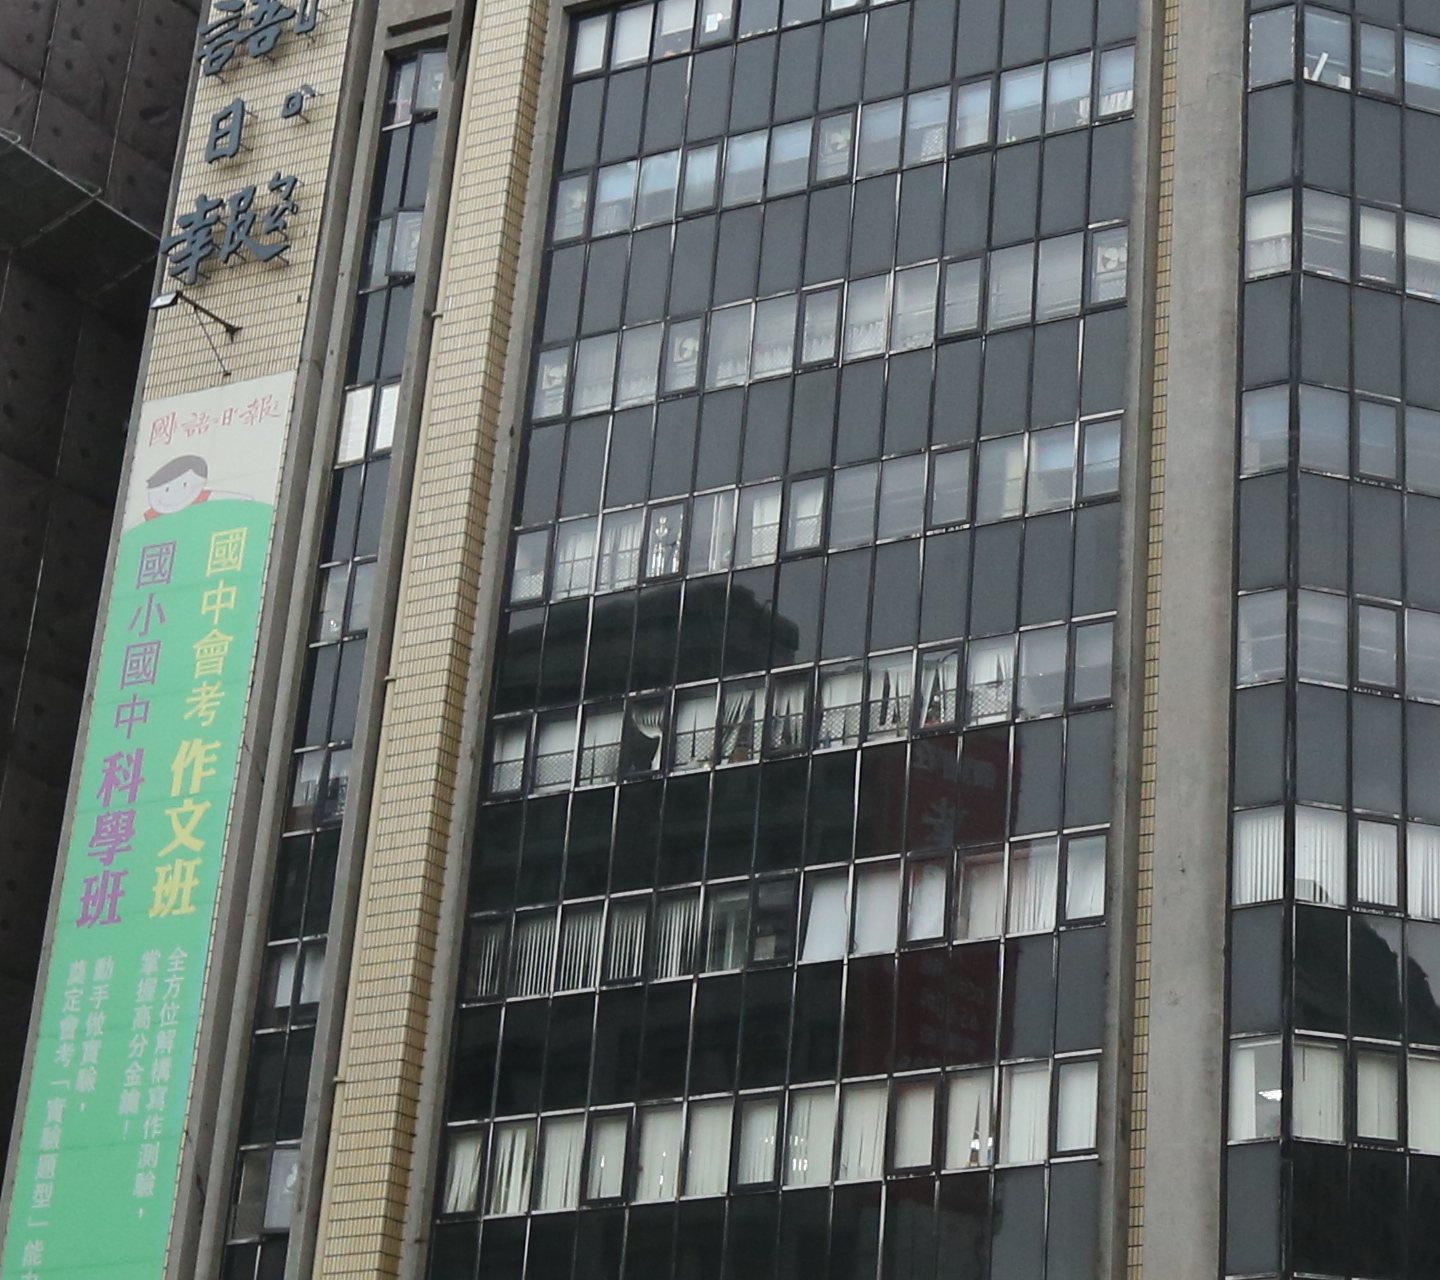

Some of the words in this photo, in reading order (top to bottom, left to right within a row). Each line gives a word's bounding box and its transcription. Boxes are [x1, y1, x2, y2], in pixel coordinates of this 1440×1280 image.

[148, 394, 282, 448] 國語日報
[75, 539, 178, 929] 國小國中科學班
[147, 526, 248, 919] 國中會考作文班
